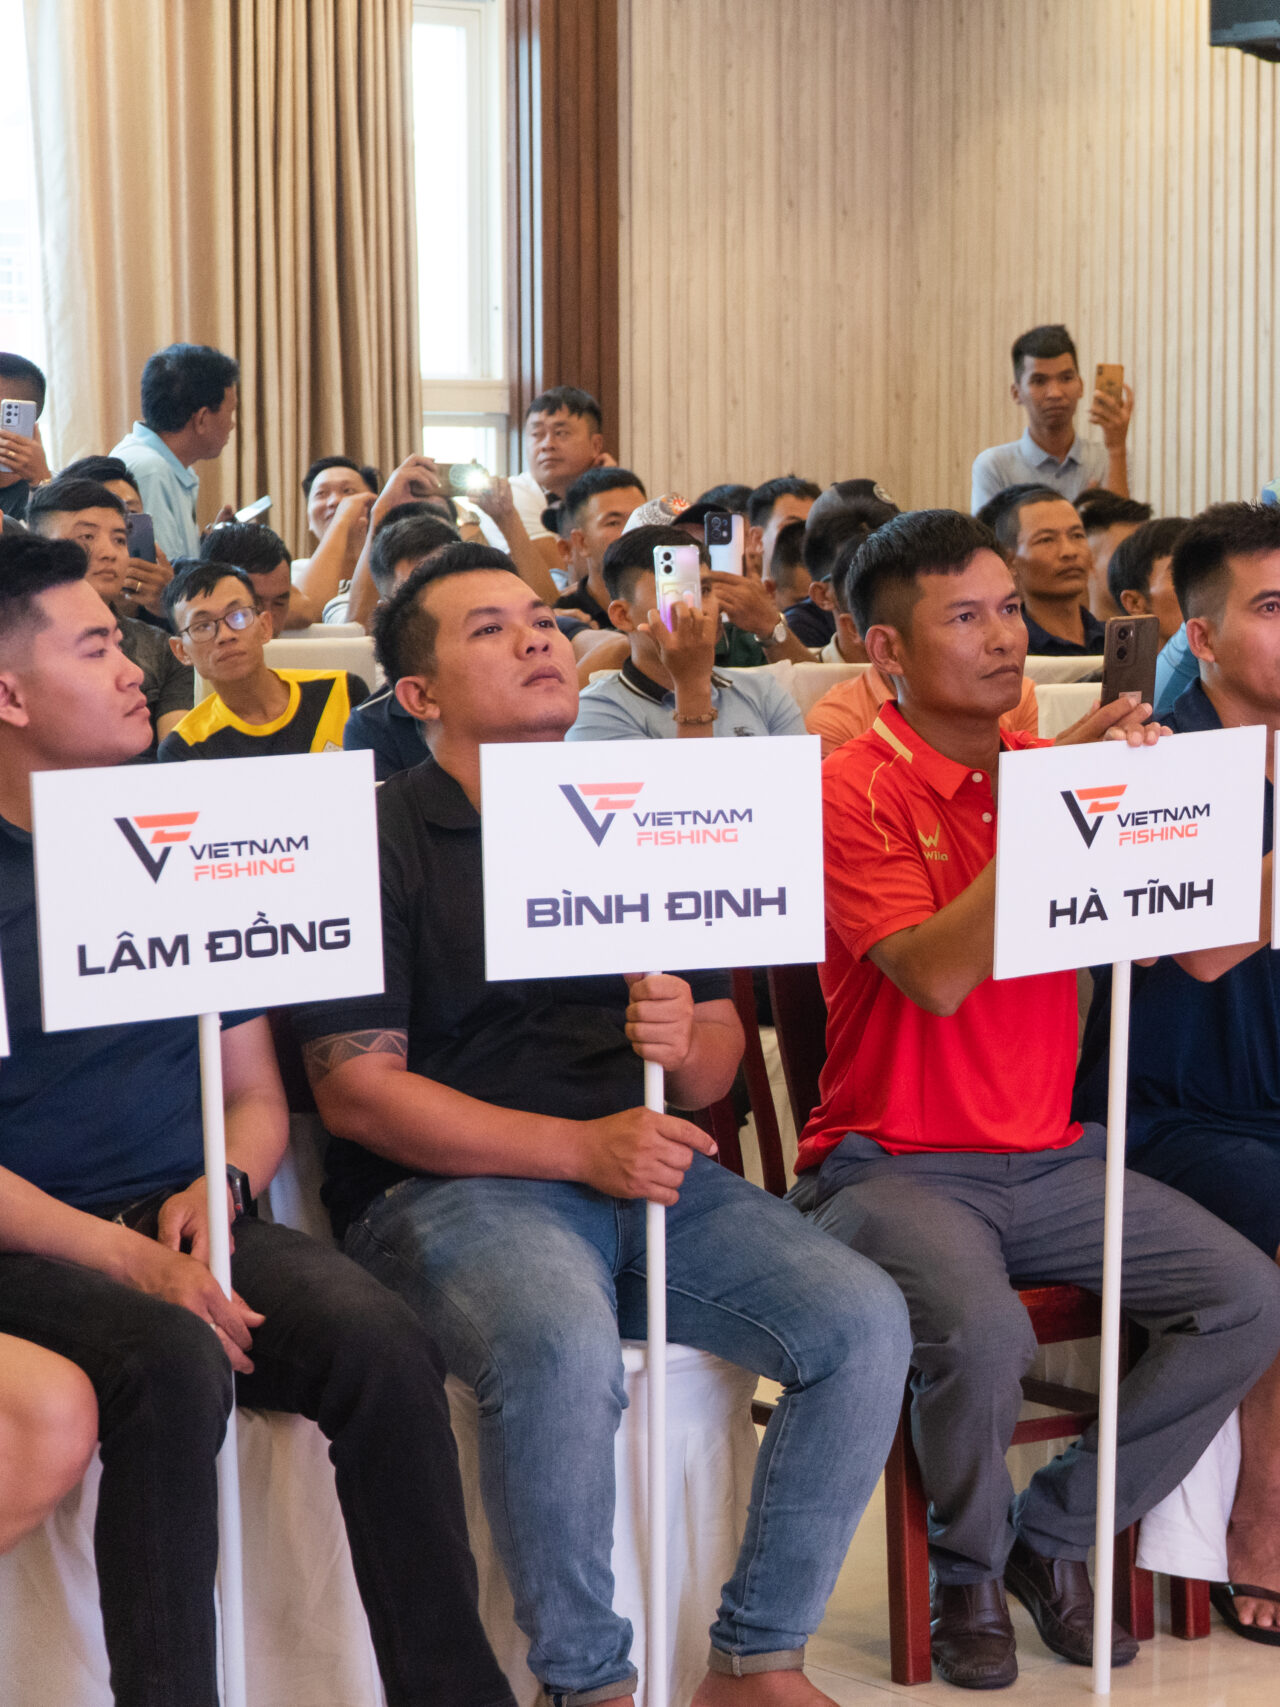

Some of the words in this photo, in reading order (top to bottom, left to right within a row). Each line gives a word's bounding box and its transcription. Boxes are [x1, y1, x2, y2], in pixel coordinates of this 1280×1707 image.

[633, 809, 752, 826] VIETNAM
[1117, 804, 1210, 827] VIETNAM
[637, 828, 738, 846] FISHING
[1119, 824, 1198, 846] FISHING
[190, 836, 308, 860] VIETNAM
[194, 857, 295, 880] FISHING
[527, 890, 649, 928] BÌNH
[665, 887, 786, 926] ĐỊNH
[1050, 888, 1108, 928] HÀ
[1124, 879, 1213, 916] TĨNH
[78, 931, 189, 976] LÂM
[205, 912, 350, 962] ĐỒNG
